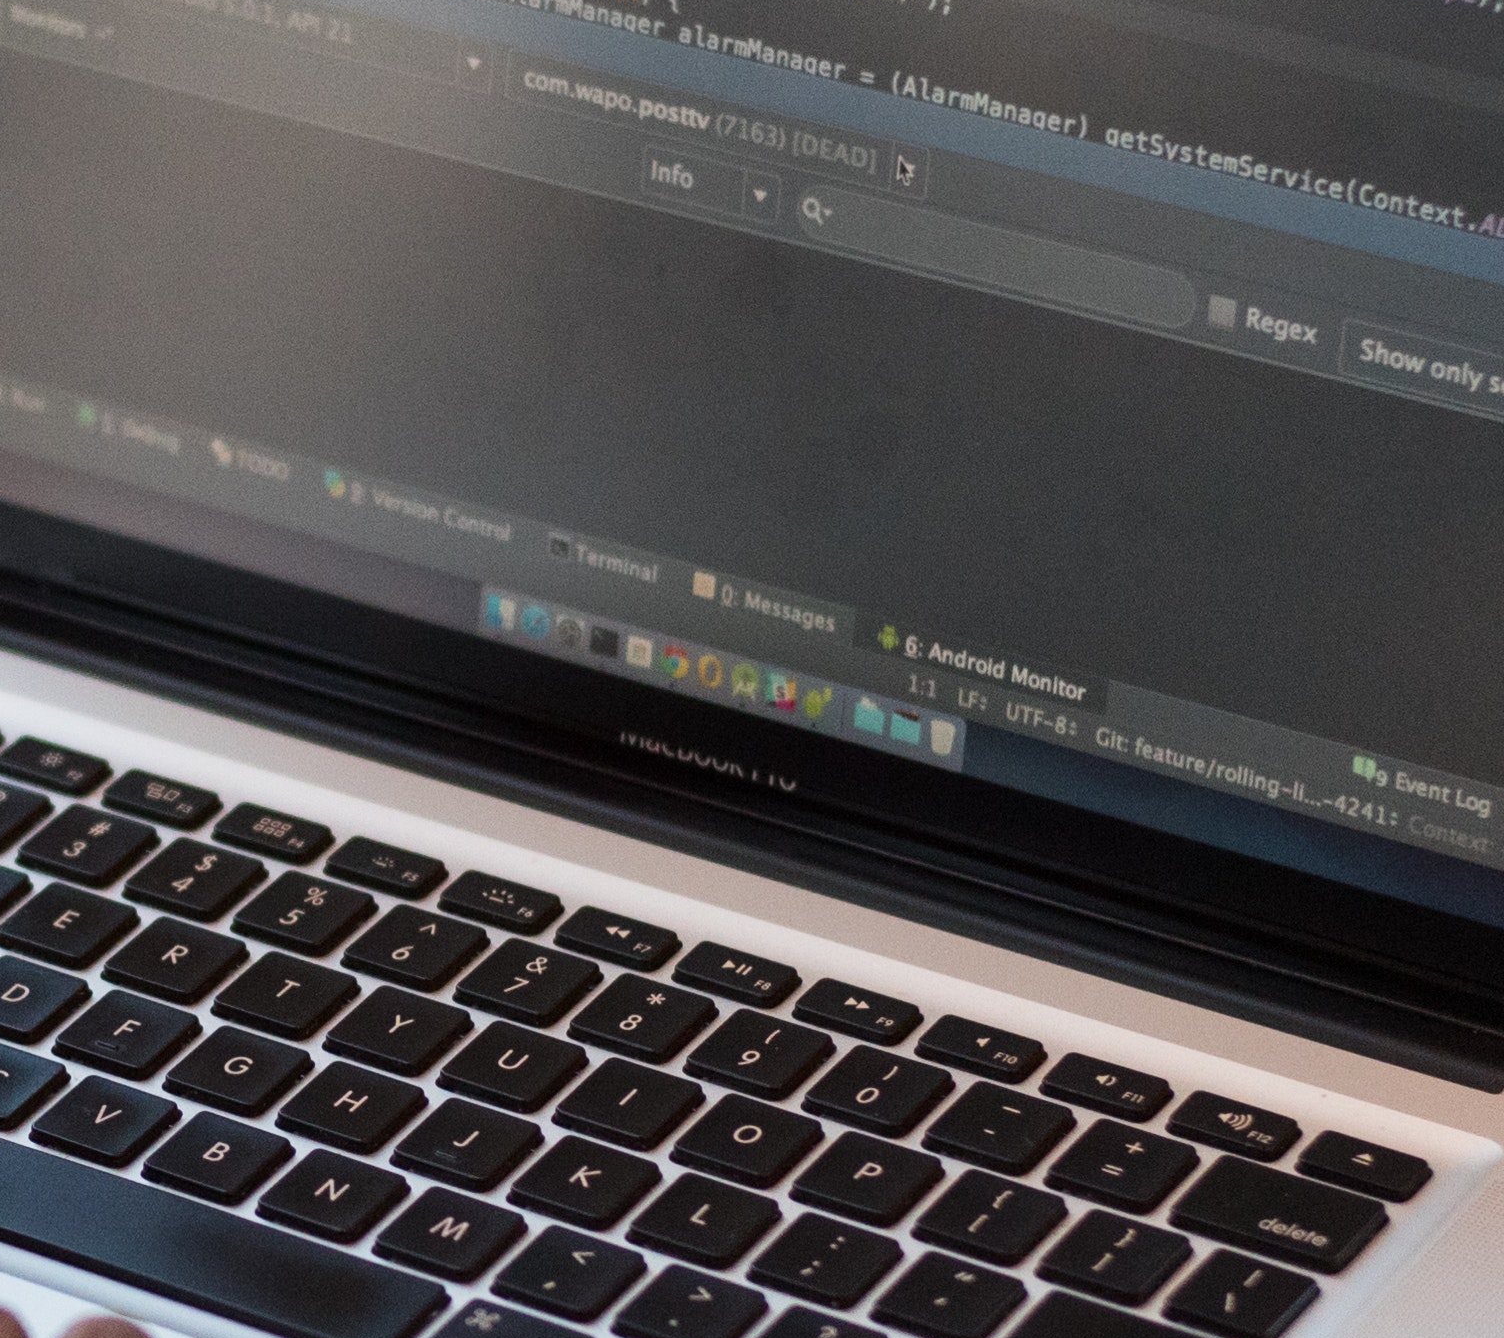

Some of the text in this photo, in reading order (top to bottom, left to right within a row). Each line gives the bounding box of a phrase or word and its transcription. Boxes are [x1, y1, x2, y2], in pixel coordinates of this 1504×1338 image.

[522, 69, 879, 176] com.wapo.posttv (7163) [DEAD]
[648, 157, 695, 191] Info
[1243, 304, 1318, 345] Regex
[1357, 334, 1426, 375] Show
[1427, 357, 1485, 396] only
[371, 486, 512, 544] Version Control
[574, 542, 659, 585] Terminal
[743, 589, 836, 634] Messages
[927, 640, 1008, 682] Android
[1009, 663, 1088, 704] Monitor
[1394, 769, 1493, 821] Event Log
[52, 909, 80, 930] E
[161, 943, 190, 965] R
[632, 942, 653, 954] F7
[0, 982, 31, 1003] D
[275, 978, 301, 998] T
[753, 979, 772, 991] F8
[113, 1018, 142, 1037] F
[388, 1014, 414, 1034] Y
[875, 1016, 895, 1028] F9
[223, 1055, 254, 1076] G
[496, 1048, 530, 1071] U
[993, 1051, 1019, 1065] F10
[333, 1089, 369, 1113] H
[618, 1087, 638, 1107] I
[94, 1104, 122, 1125] V
[452, 1130, 480, 1148] J
[732, 1124, 764, 1145] O
[202, 1141, 231, 1162] B
[569, 1165, 602, 1188] K
[853, 1161, 884, 1180] P
[314, 1178, 350, 1202] N
[689, 1203, 710, 1226] L
[429, 1216, 470, 1242] M
[1258, 1218, 1329, 1248] delete
